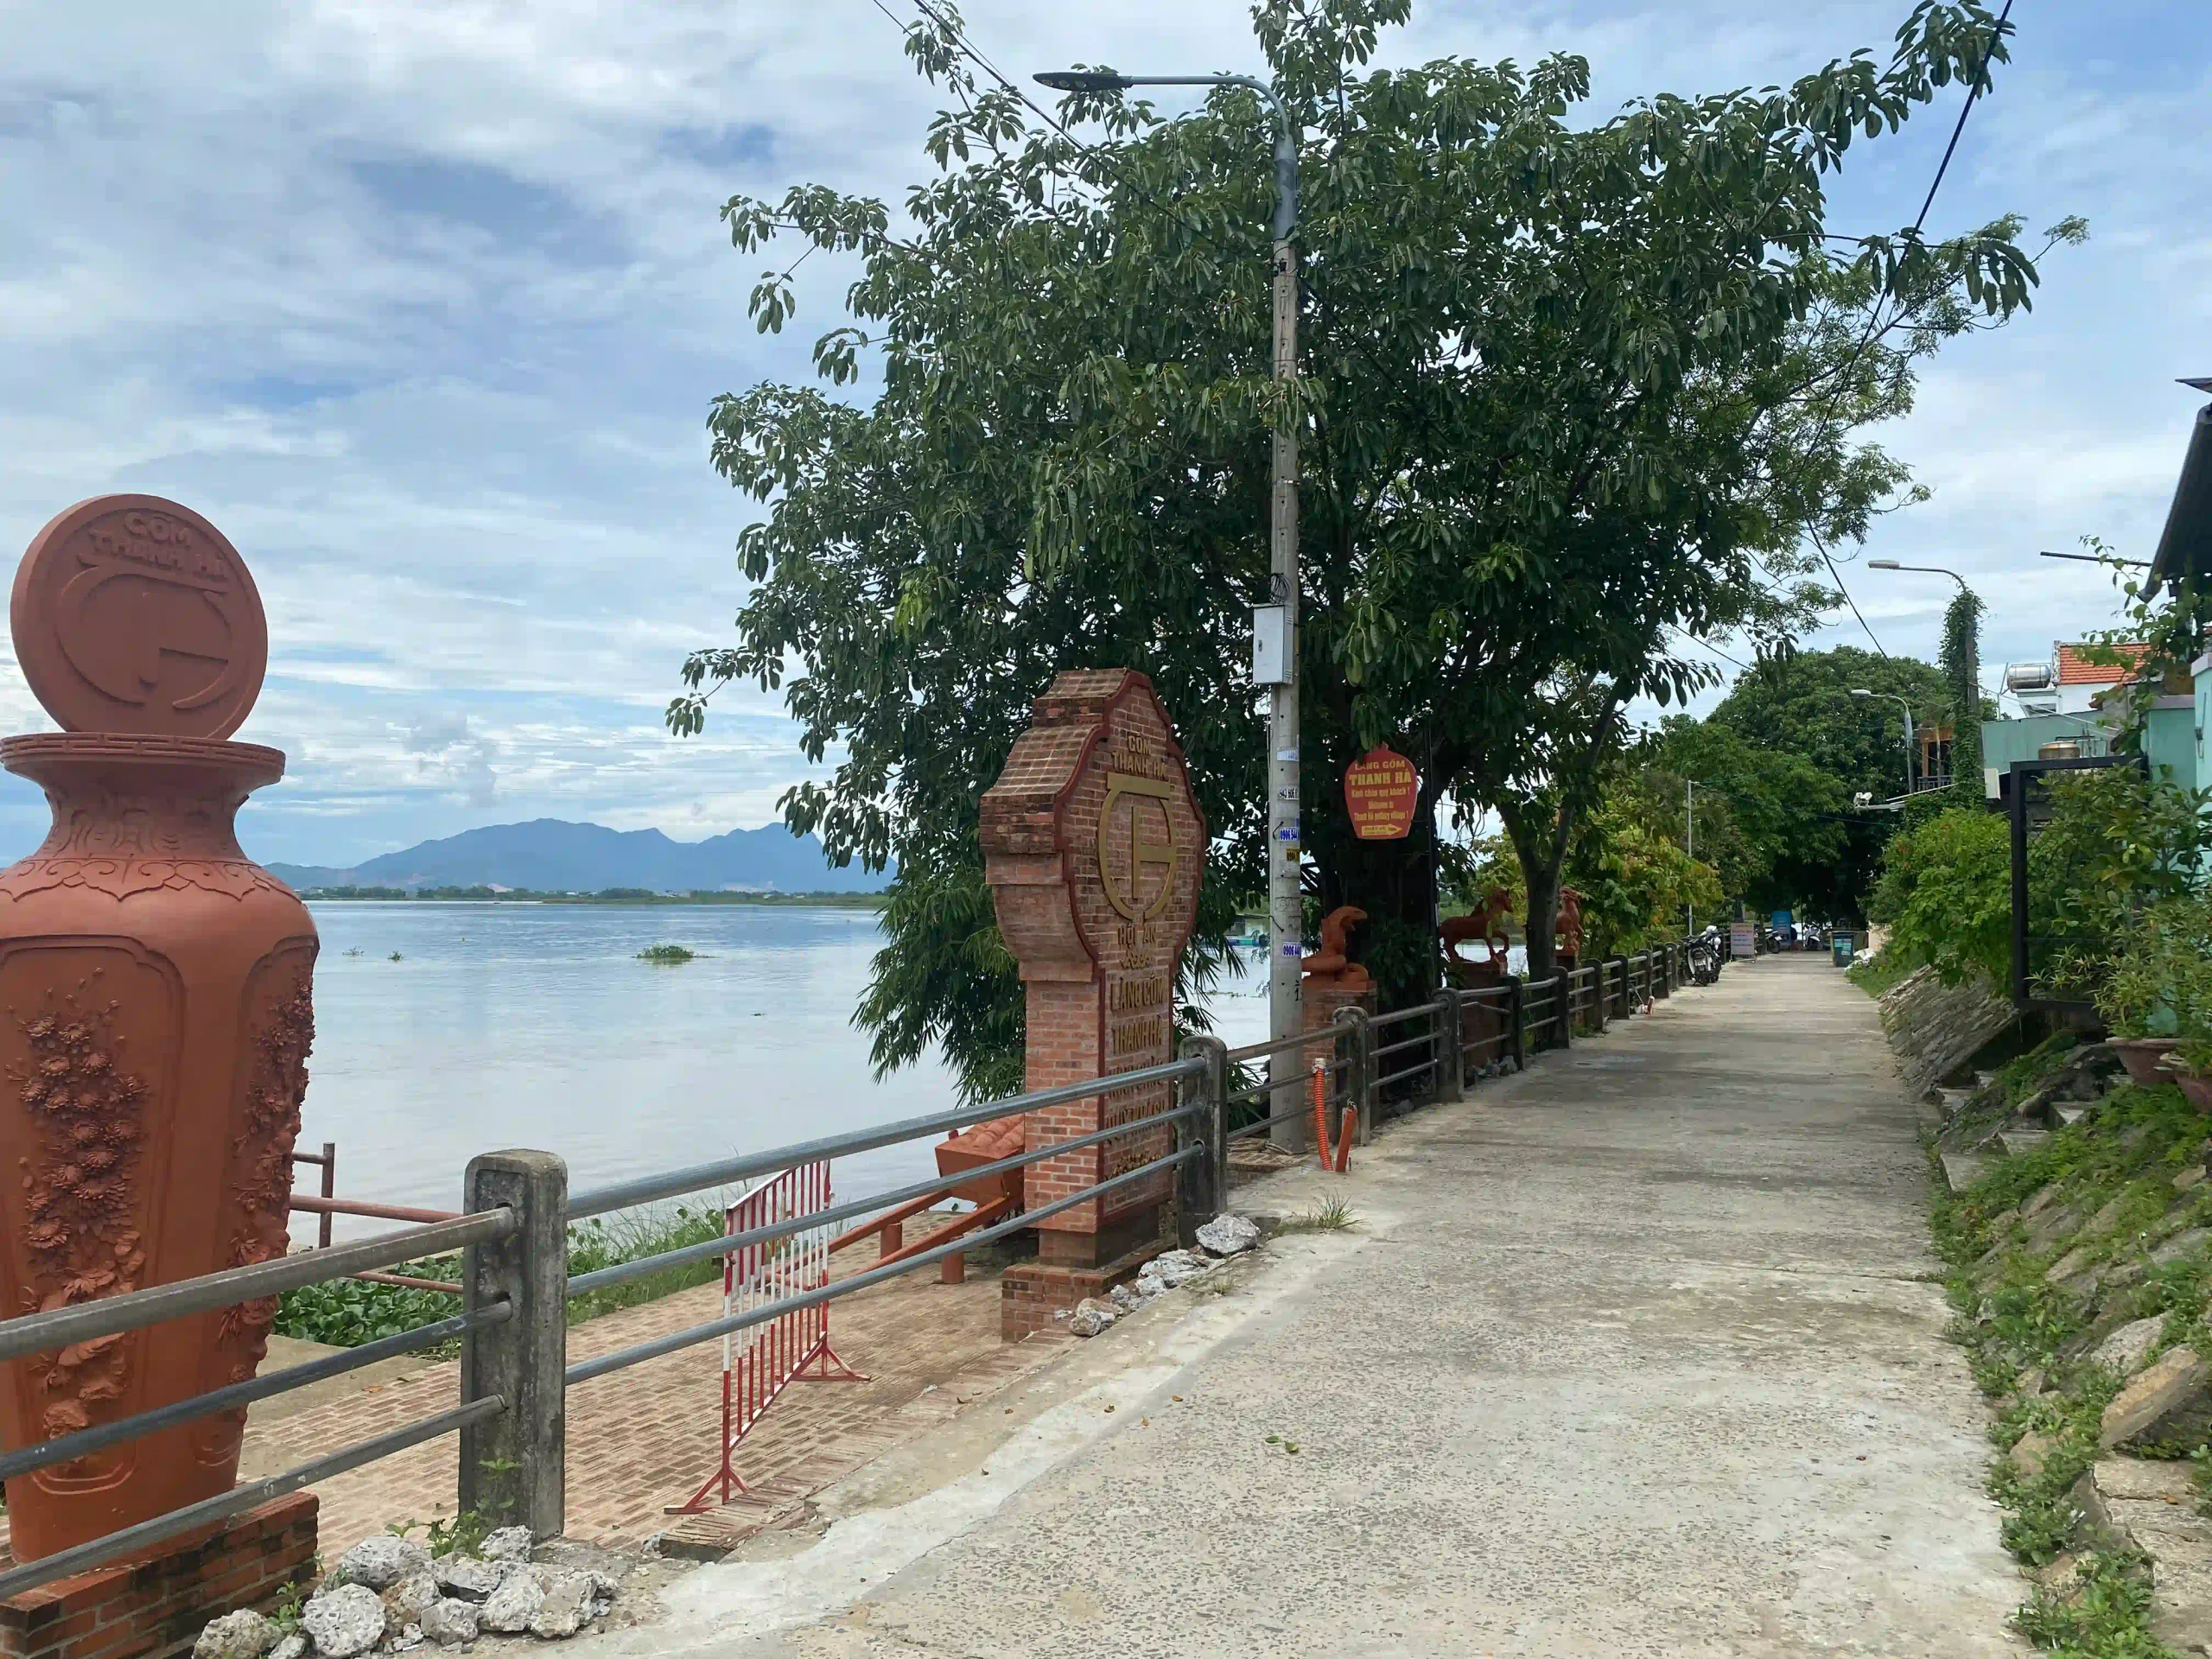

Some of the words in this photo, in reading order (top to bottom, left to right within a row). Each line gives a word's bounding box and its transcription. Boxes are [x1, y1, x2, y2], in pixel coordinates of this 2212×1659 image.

[1110, 750, 1148, 776] THANH
[1349, 772, 1391, 785] THANH
[1141, 925, 1156, 944] AN
[1110, 977, 1140, 1012] LÀNG
[1111, 1021, 1147, 1054] THANH
